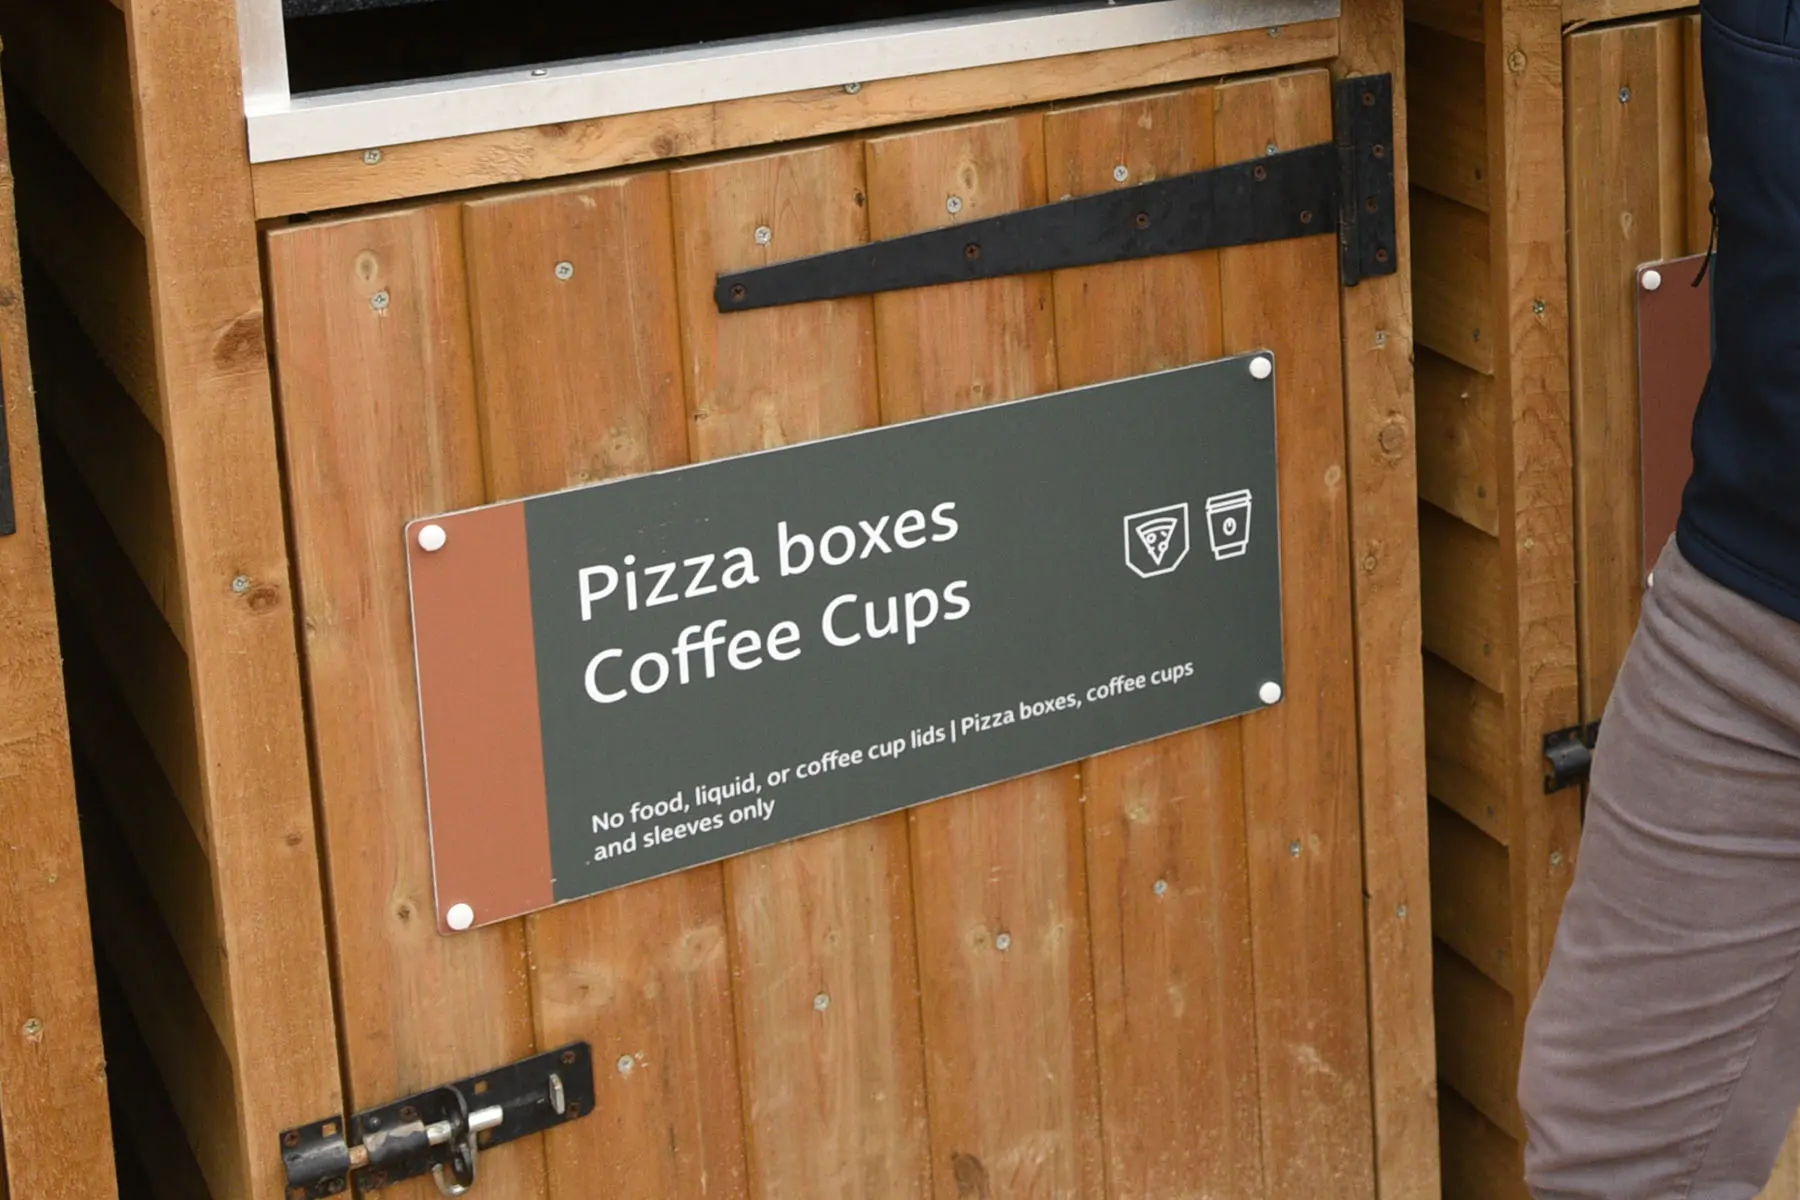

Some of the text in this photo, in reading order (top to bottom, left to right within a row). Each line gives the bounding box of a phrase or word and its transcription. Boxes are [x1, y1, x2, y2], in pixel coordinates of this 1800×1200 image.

[578, 501, 959, 622] Pizza boxes
[584, 579, 971, 704] Coffee Cups
[592, 811, 625, 834] No
[629, 791, 690, 823] food,
[695, 771, 762, 806] liquid,
[767, 767, 791, 787] or
[795, 749, 863, 779] coffee
[867, 738, 906, 760] cup
[910, 725, 946, 749] lids
[961, 709, 1016, 736] Pizza
[1019, 692, 1082, 720] boxes,
[1086, 674, 1146, 702] coffee
[1150, 662, 1194, 685] cups
[594, 797, 776, 862] and sleeves only
